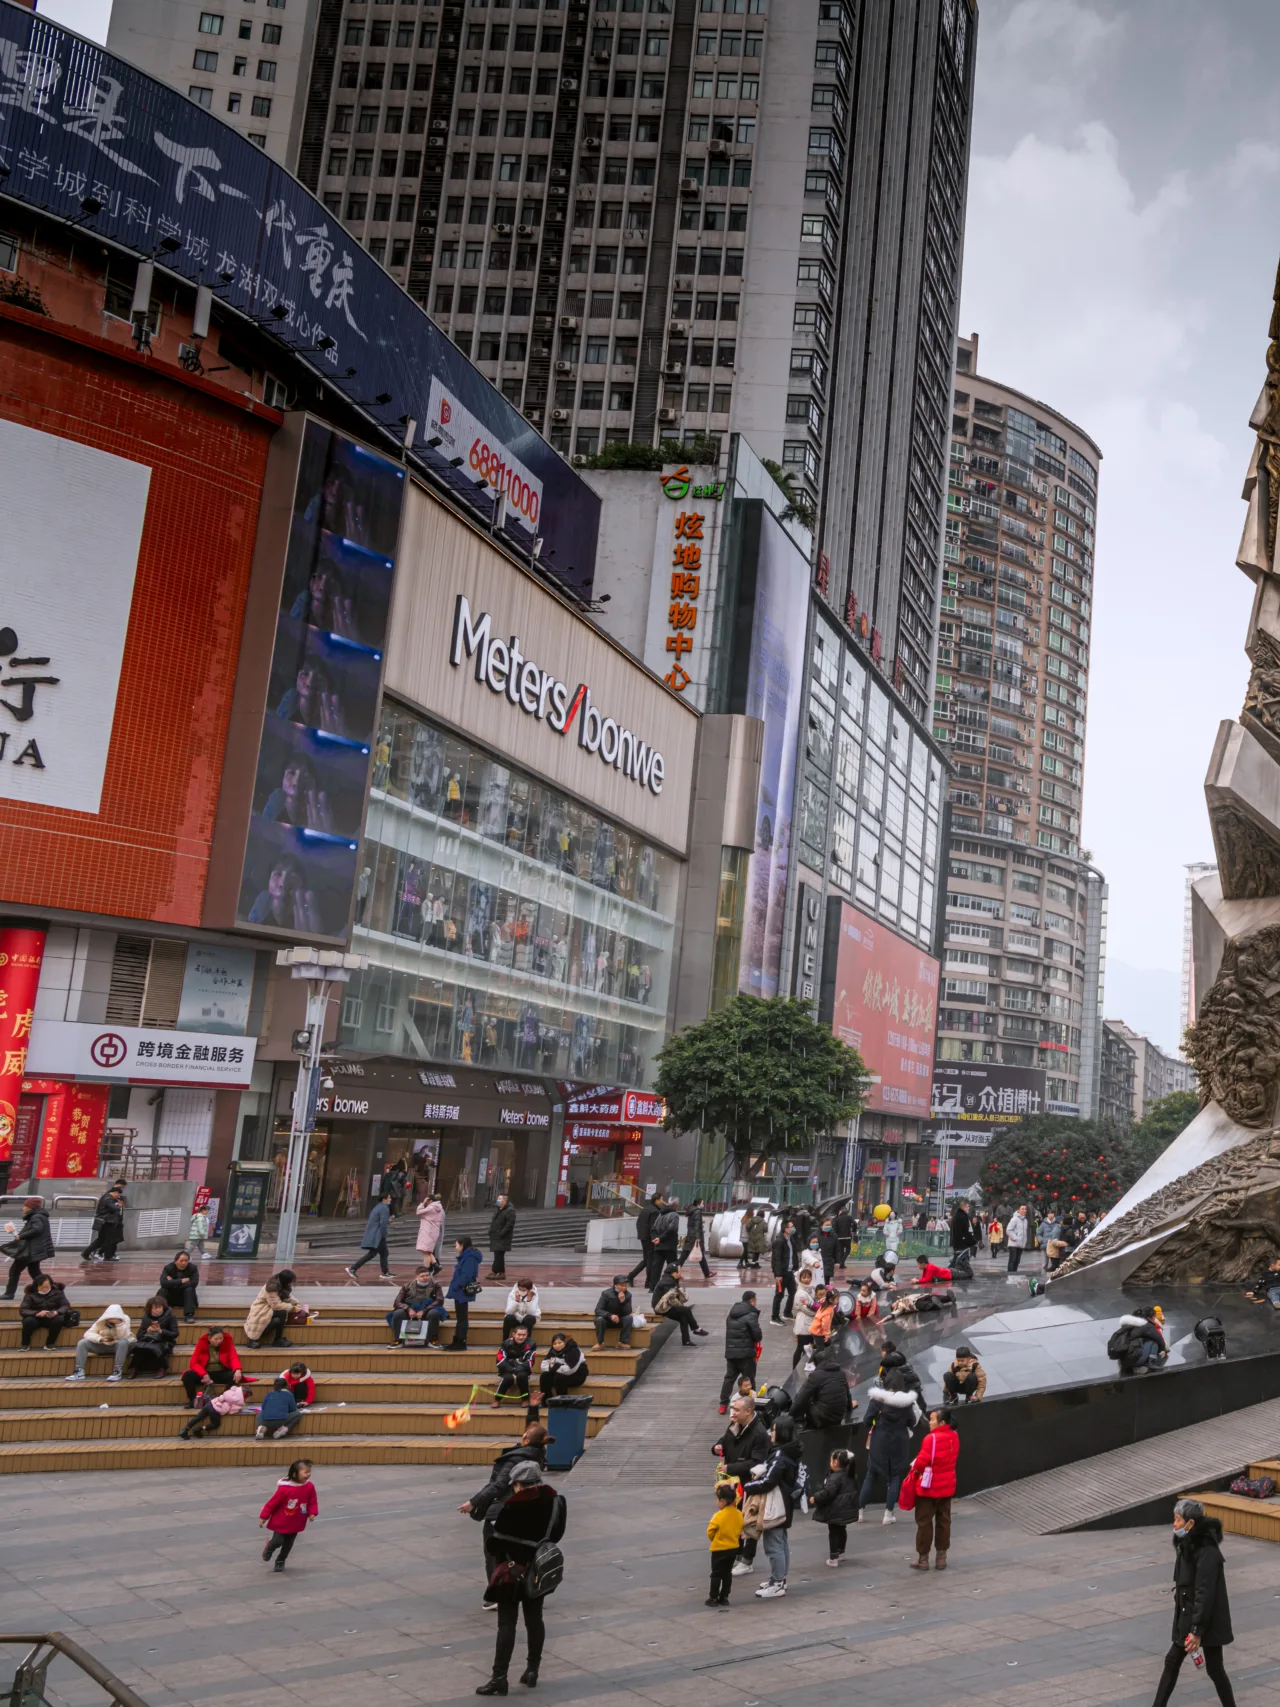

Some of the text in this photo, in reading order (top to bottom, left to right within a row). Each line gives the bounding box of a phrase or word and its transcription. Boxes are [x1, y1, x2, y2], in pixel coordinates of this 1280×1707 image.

[469, 438, 539, 524] 68811000
[664, 511, 705, 691] 炫地购物中心
[450, 594, 665, 796] Meters/bonwe
[137, 1040, 245, 1064] 跨境金融服务
[158, 1062, 184, 1070] BORDER
[185, 1064, 215, 1072] FINANCIAL
[423, 1103, 460, 1121] 美特斯邦威
